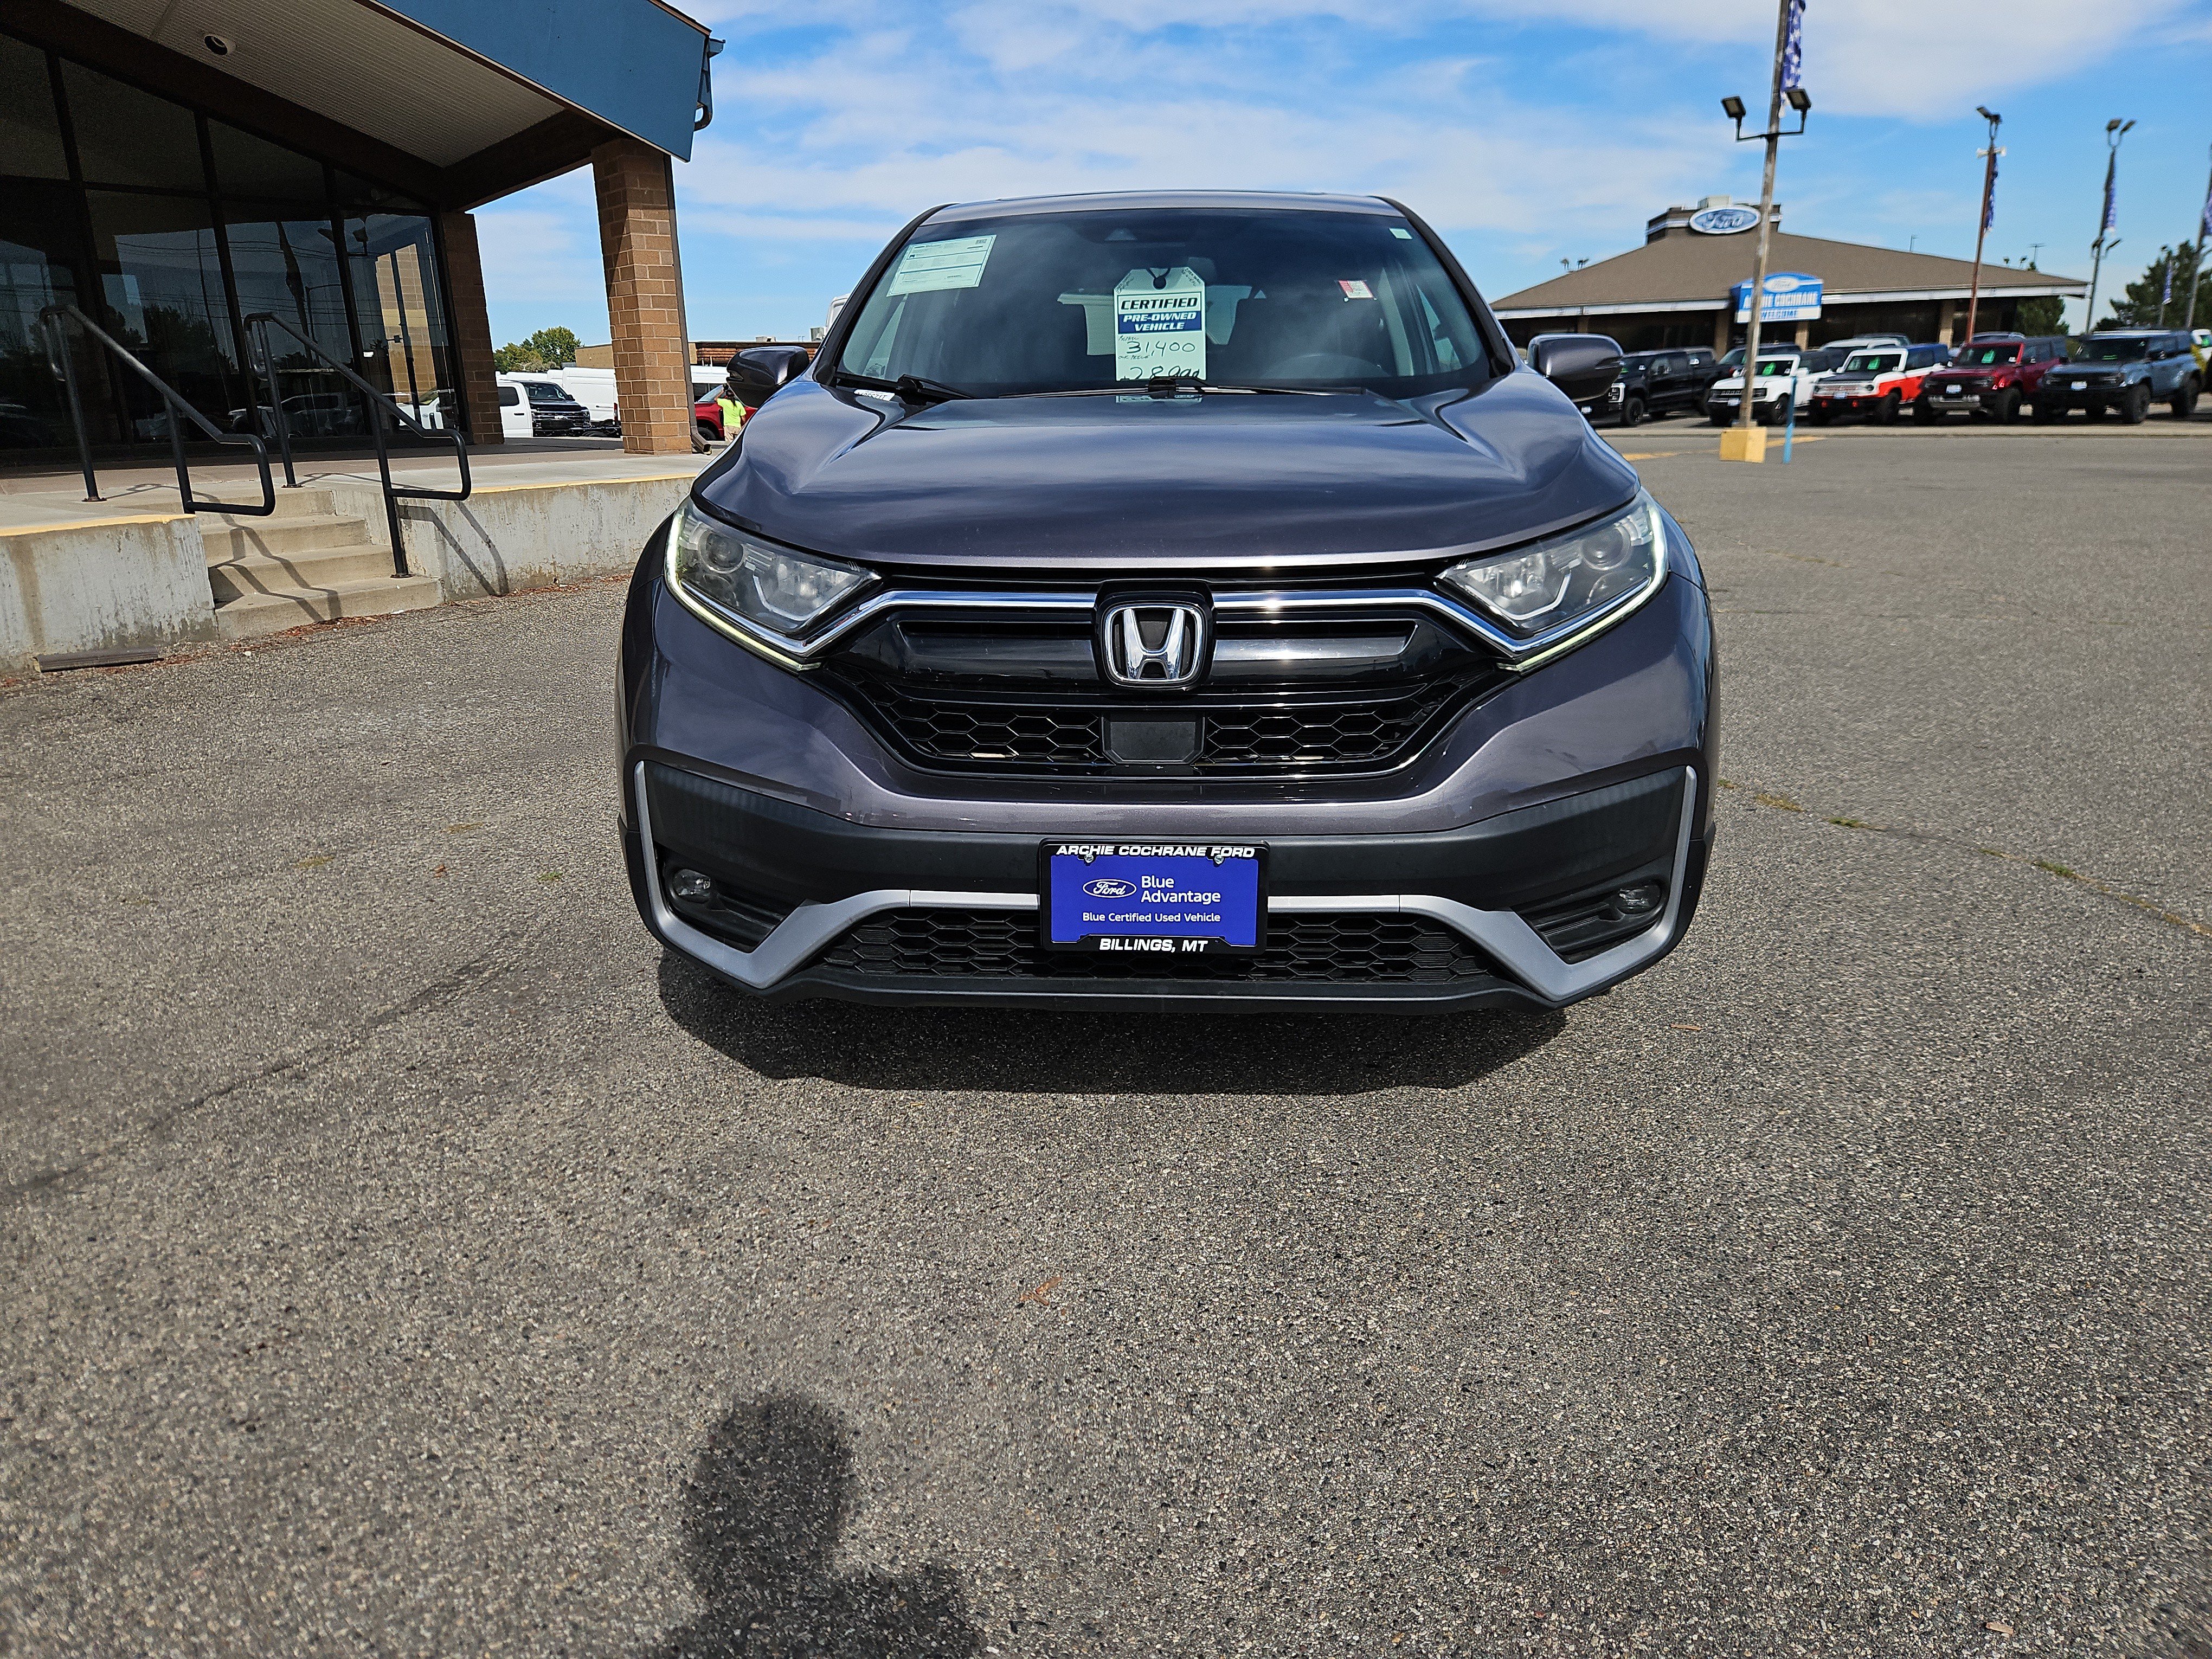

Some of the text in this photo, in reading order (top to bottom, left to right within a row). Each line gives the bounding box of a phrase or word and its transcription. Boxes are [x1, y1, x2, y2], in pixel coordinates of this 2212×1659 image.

[1121, 297, 1198, 310] CERTIFIED
[1123, 312, 1197, 323] PRE-OWNED
[1135, 322, 1185, 332] VEHICLE
[1056, 845, 1255, 858] ARCHIE COCHRANE FORD
[1093, 881, 1127, 895] Ford
[1141, 876, 1174, 888] Blue
[1141, 890, 1221, 905] Advantage
[1083, 912, 1221, 922] Blue Certified Used Vehicle
[1099, 938, 1208, 953] BILLINGS, MT
